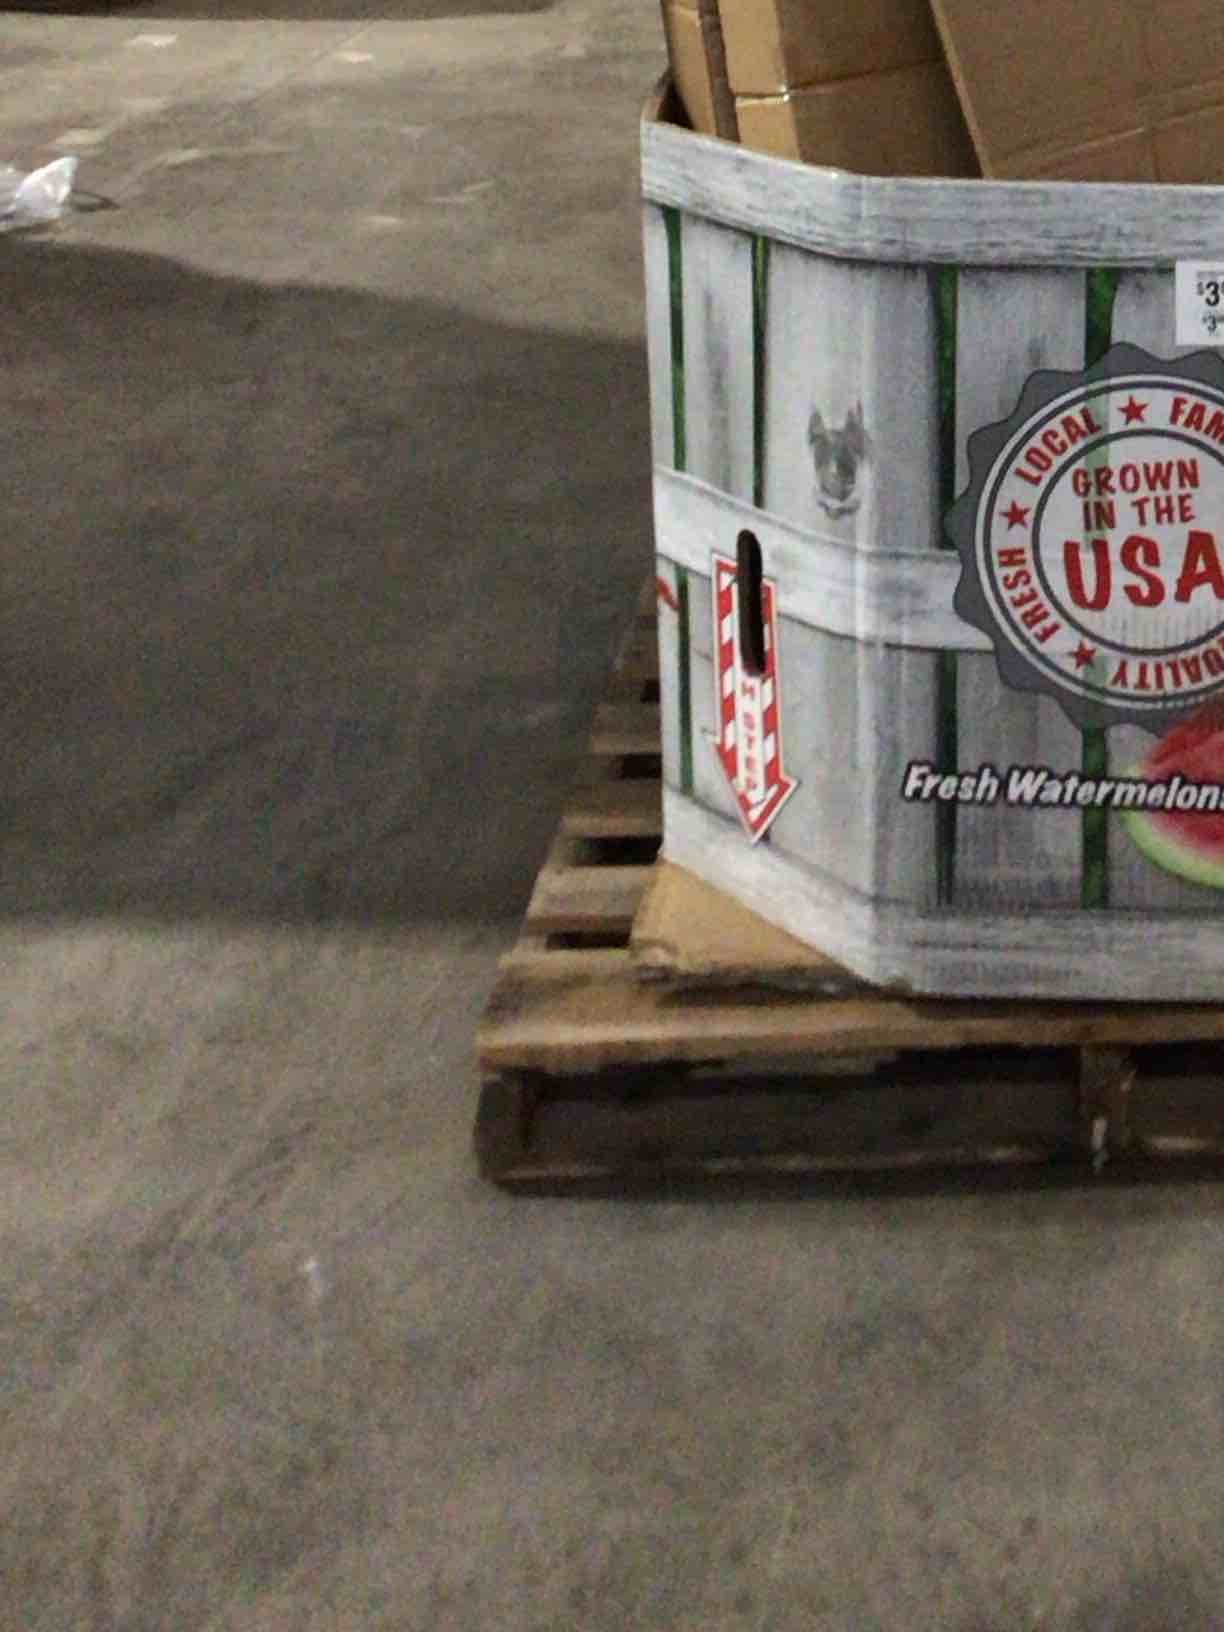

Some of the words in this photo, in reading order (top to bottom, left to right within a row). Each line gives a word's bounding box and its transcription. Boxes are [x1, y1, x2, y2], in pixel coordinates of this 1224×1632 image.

[1014, 405, 1101, 486] LOCAL
[1072, 457, 1200, 498] GROWN
[1083, 499, 1116, 532] IN
[1131, 493, 1195, 526] THE
[997, 547, 1061, 644] FRESH
[903, 764, 999, 802] Fresh
